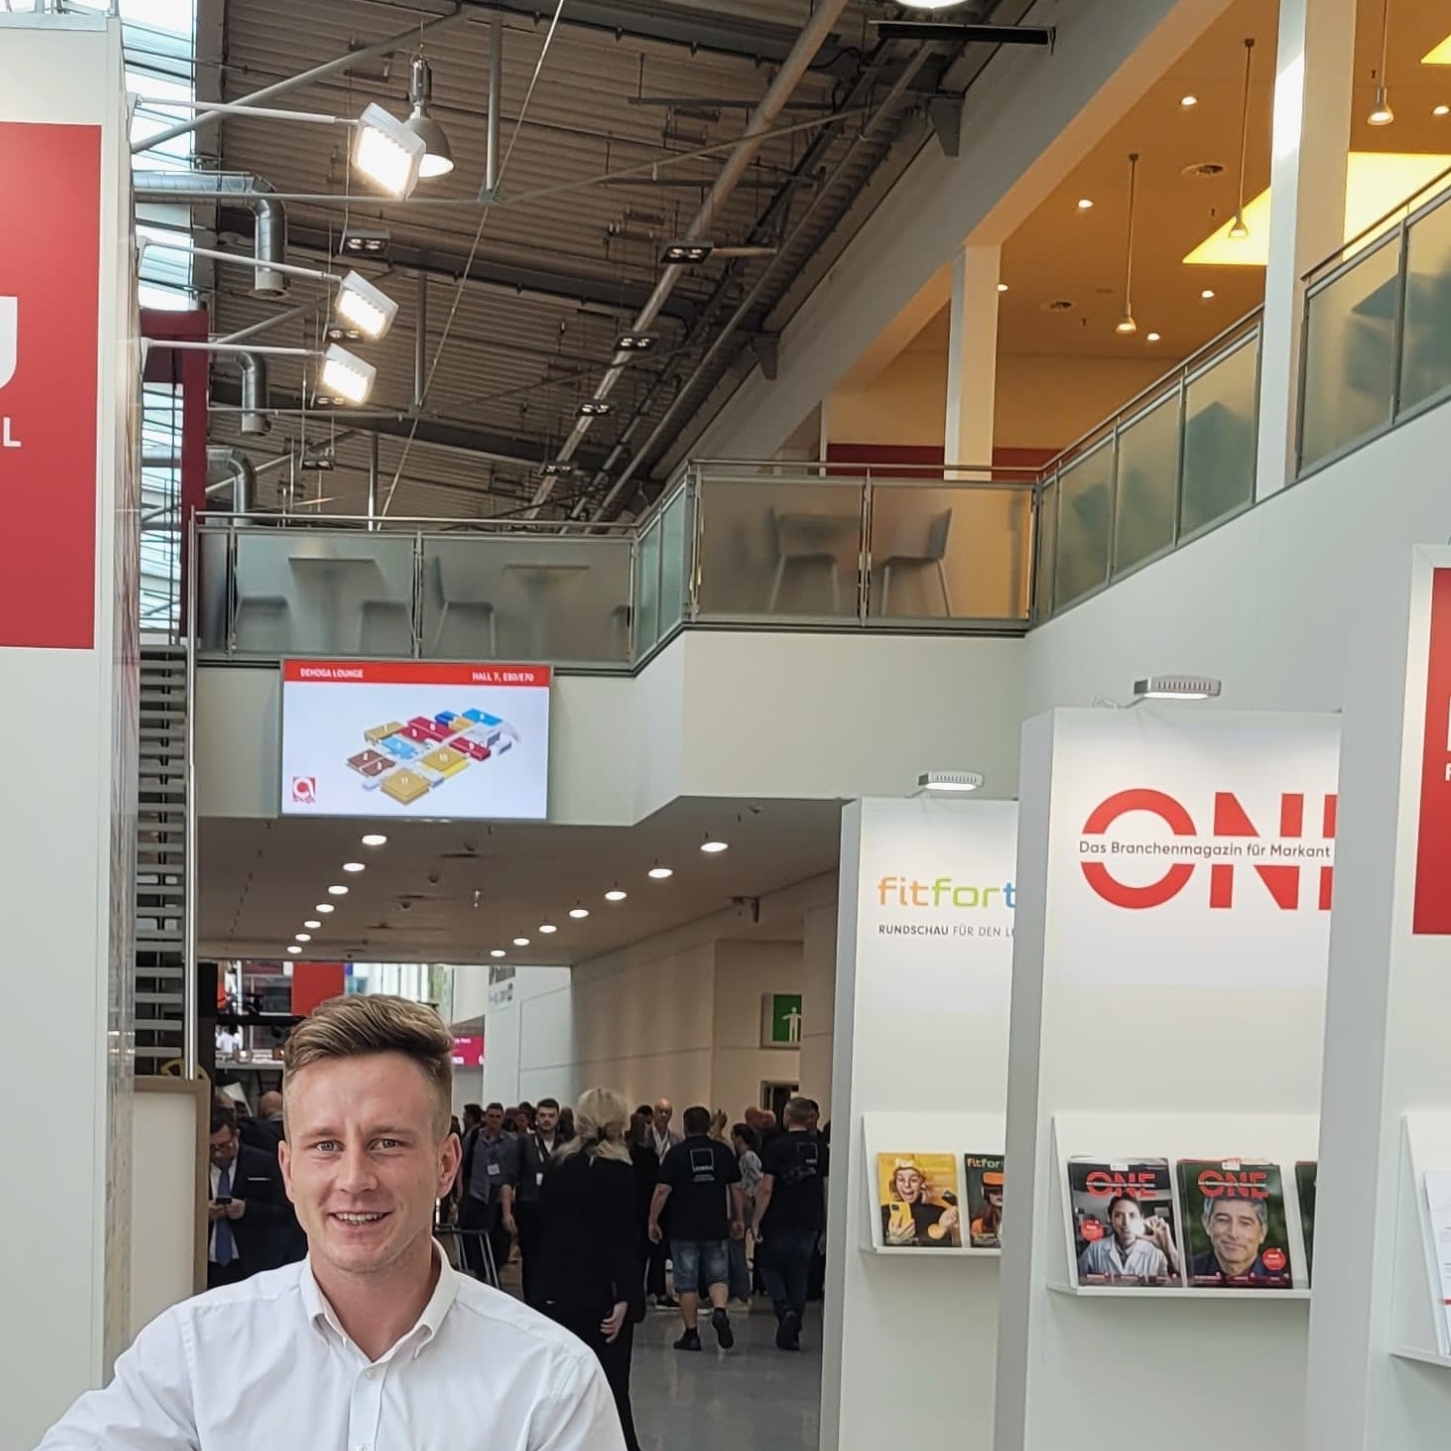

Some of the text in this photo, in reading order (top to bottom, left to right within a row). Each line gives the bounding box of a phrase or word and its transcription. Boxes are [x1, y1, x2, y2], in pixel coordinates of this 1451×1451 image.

[333, 669, 363, 679] LOUNGE
[472, 672, 492, 682] HALL
[1079, 840, 1331, 859] Das Branchenmagazin für Markant
[879, 924, 1001, 937] RUNDSCHAU FÜR DEN
[1086, 1171, 1156, 1198] ONE
[1197, 1169, 1269, 1199] ONE
